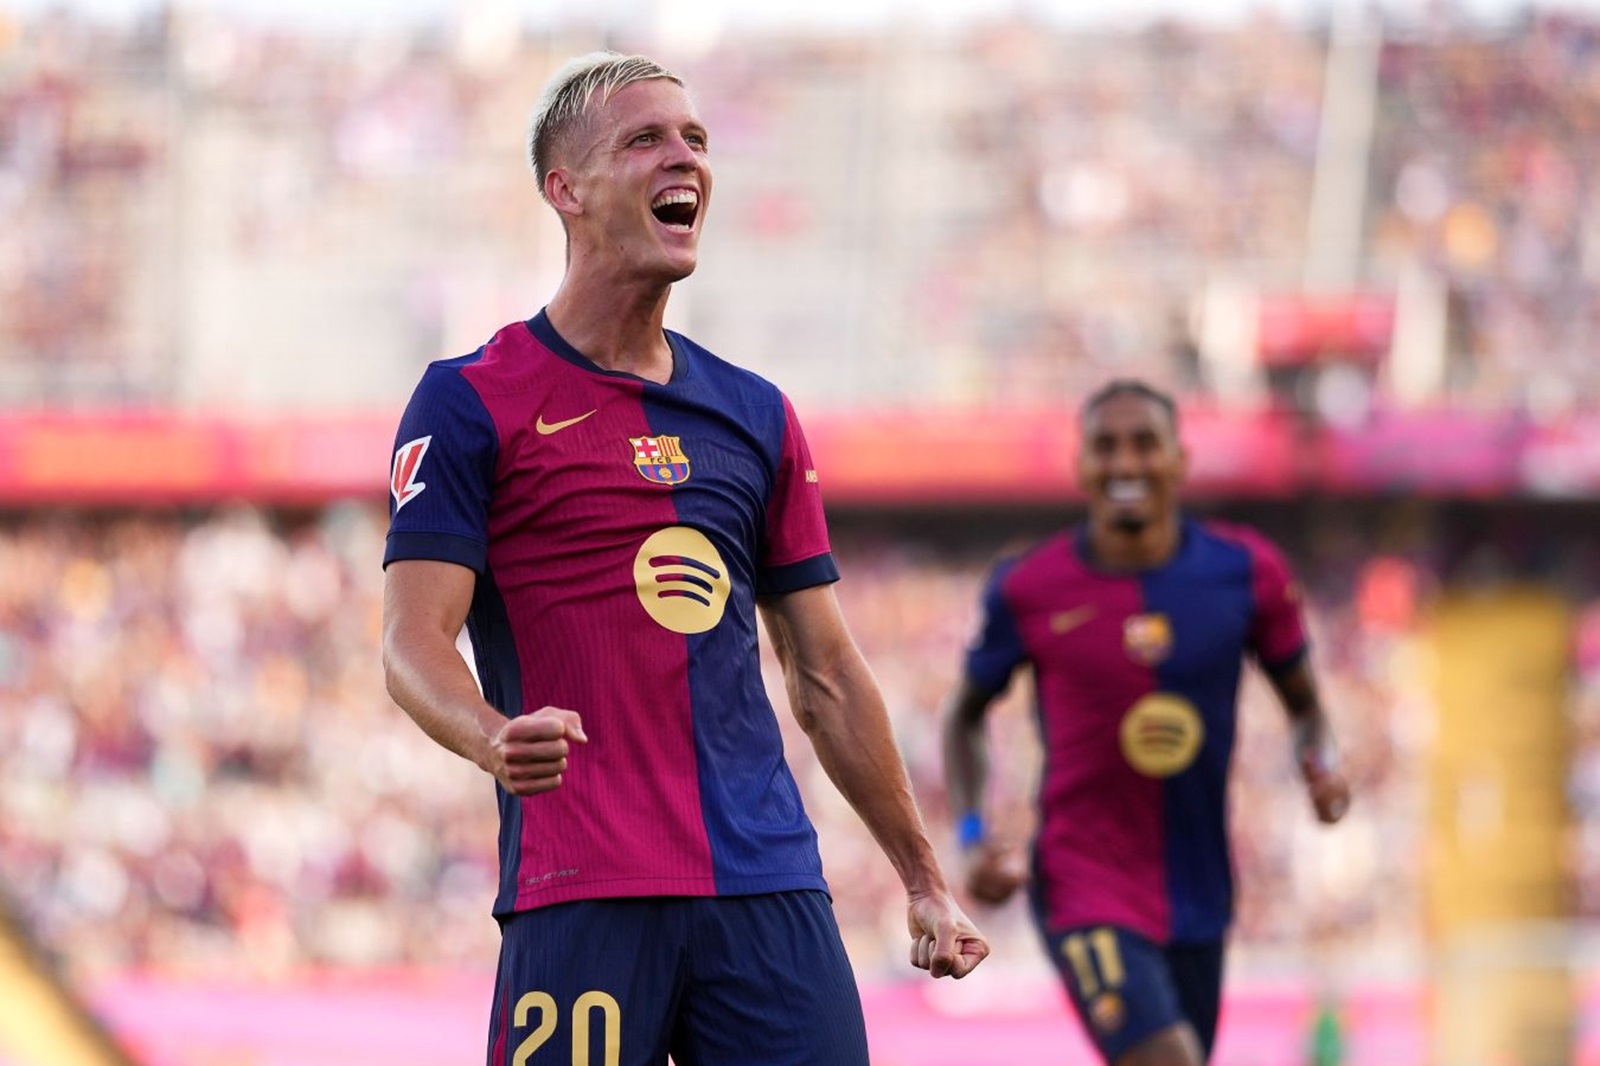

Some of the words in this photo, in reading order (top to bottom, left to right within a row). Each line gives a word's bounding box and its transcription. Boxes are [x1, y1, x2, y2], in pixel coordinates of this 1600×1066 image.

[650, 456, 672, 464] FCB
[1061, 928, 1126, 998] 11
[512, 990, 621, 1066] 20
